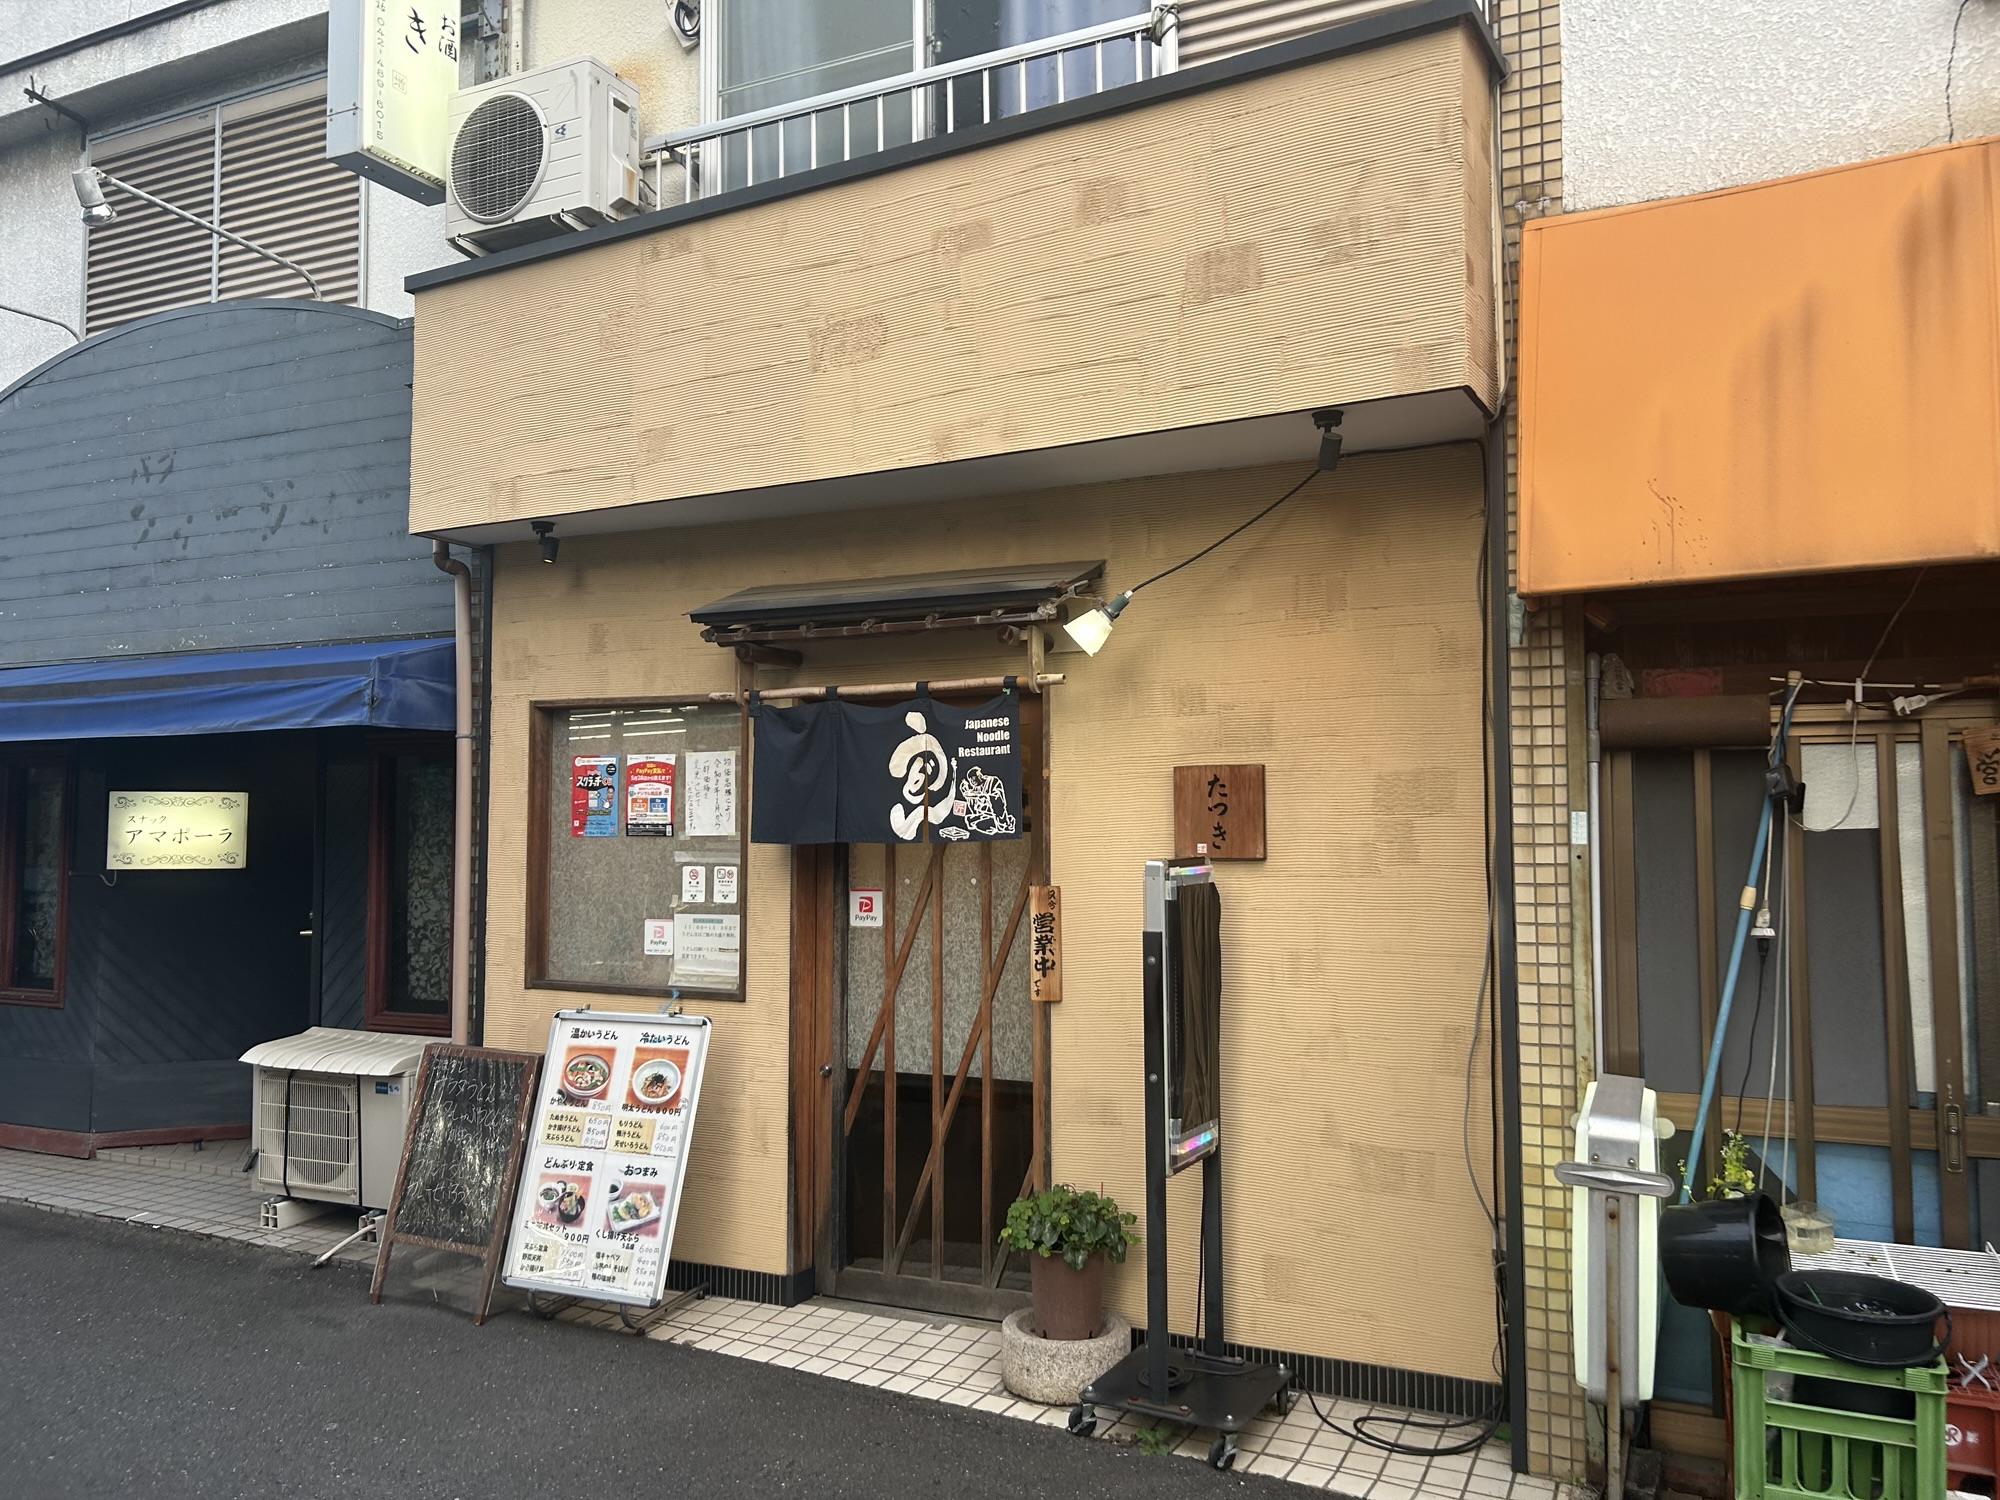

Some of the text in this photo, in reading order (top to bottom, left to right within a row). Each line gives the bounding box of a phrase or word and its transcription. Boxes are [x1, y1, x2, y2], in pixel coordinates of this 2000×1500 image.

[964, 716, 1010, 730] Japanese
[976, 730, 1010, 743] Noodle
[958, 744, 1011, 758] Restaurant
[1207, 774, 1228, 850] たつき
[127, 815, 167, 824] スナック
[125, 828, 233, 845] アマポーラ
[855, 914, 878, 922] PayPay
[1033, 912, 1056, 978] 営業中
[570, 1027, 618, 1040] 温かいうどん
[639, 1032, 690, 1045] 冷たいうどん
[622, 1104, 681, 1116] 明太うどん 800円
[550, 1114, 578, 1122] たぬきうどん
[619, 1120, 643, 1128] もりうどん
[548, 1124, 581, 1133] かき揚げうどん
[614, 1140, 648, 1150] 天せいろうどん
[623, 1164, 658, 1178] おつまみ
[564, 1233, 589, 1244] 900円
[596, 1229, 639, 1242] くし揚げ天ぷら
